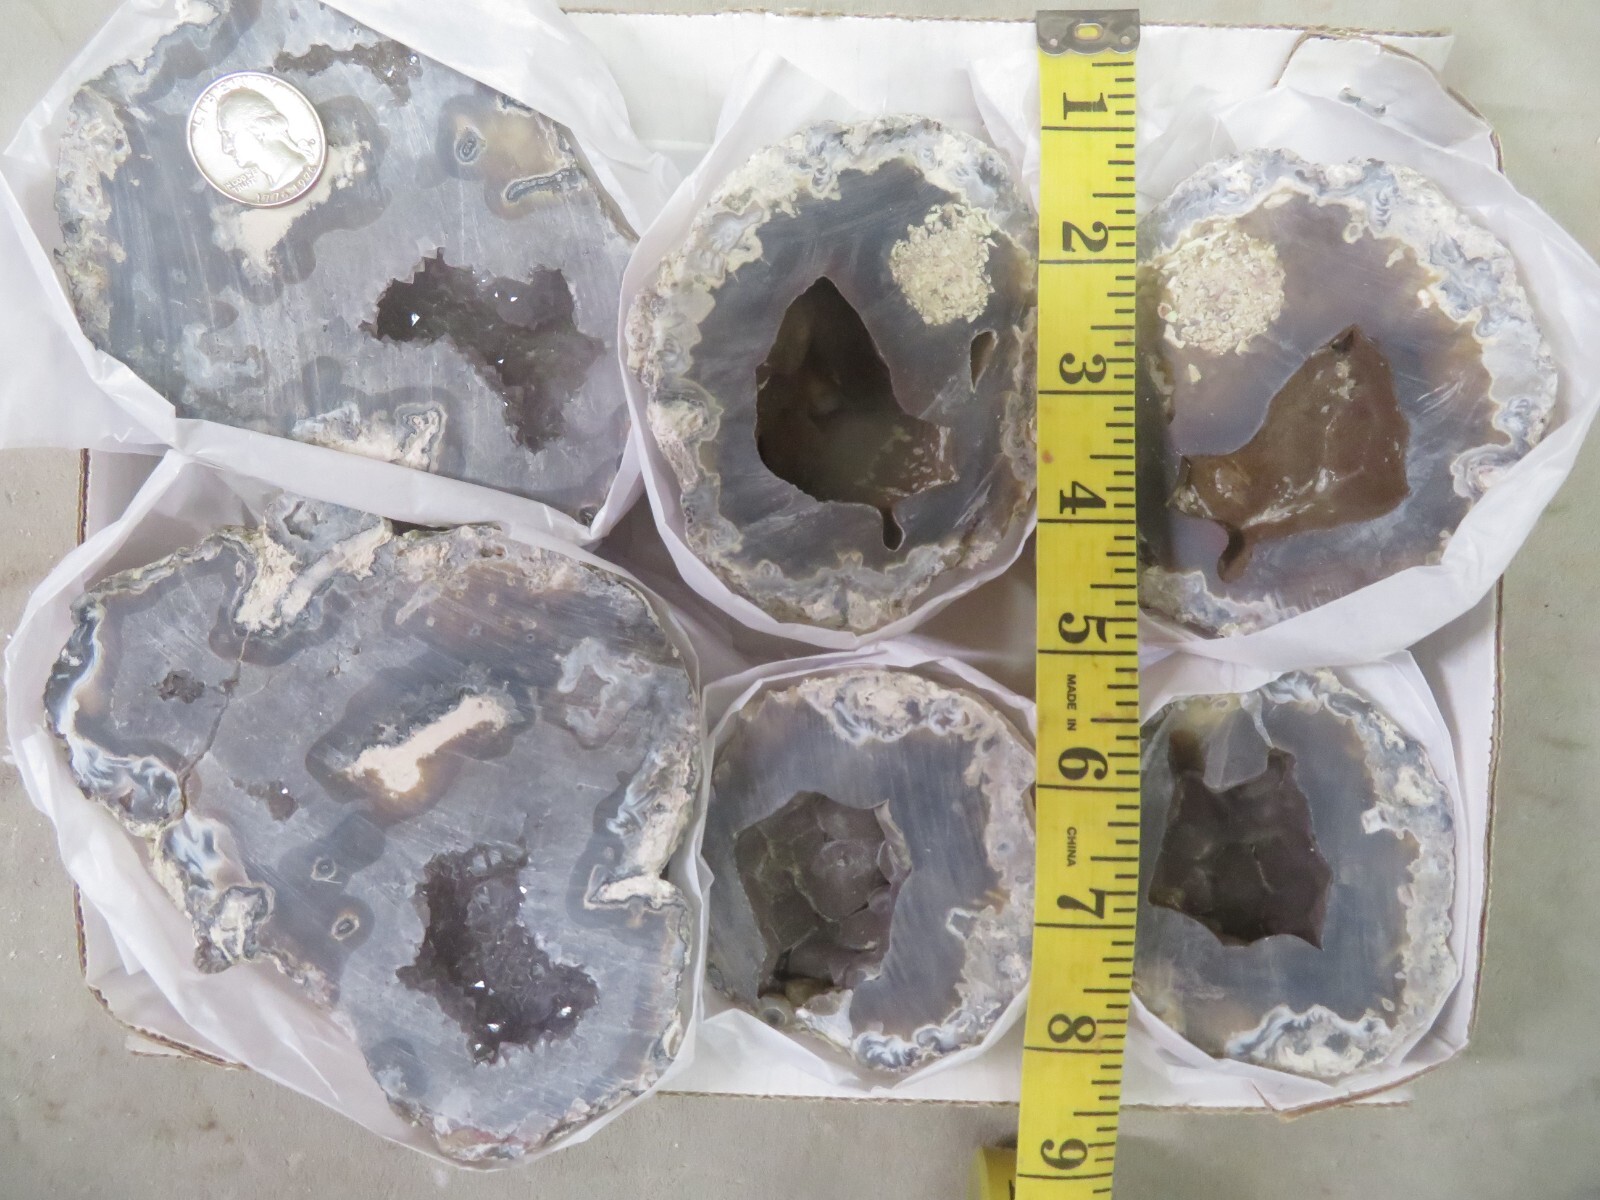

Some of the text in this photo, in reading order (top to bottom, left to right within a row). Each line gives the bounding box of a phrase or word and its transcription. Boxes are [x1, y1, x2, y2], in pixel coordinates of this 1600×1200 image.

[191, 76, 278, 128] LIBERY
[1062, 92, 1108, 120] 1
[1062, 221, 1109, 252] 2
[1059, 352, 1107, 385] 3
[1059, 481, 1107, 515] 4
[1058, 612, 1108, 644] 5
[1066, 674, 1077, 731] MADE IN
[1058, 747, 1109, 780] 6
[1066, 826, 1078, 867] CHINA
[1056, 887, 1107, 920] 7
[1047, 1013, 1097, 1043] 8
[1040, 1138, 1088, 1170] 9
